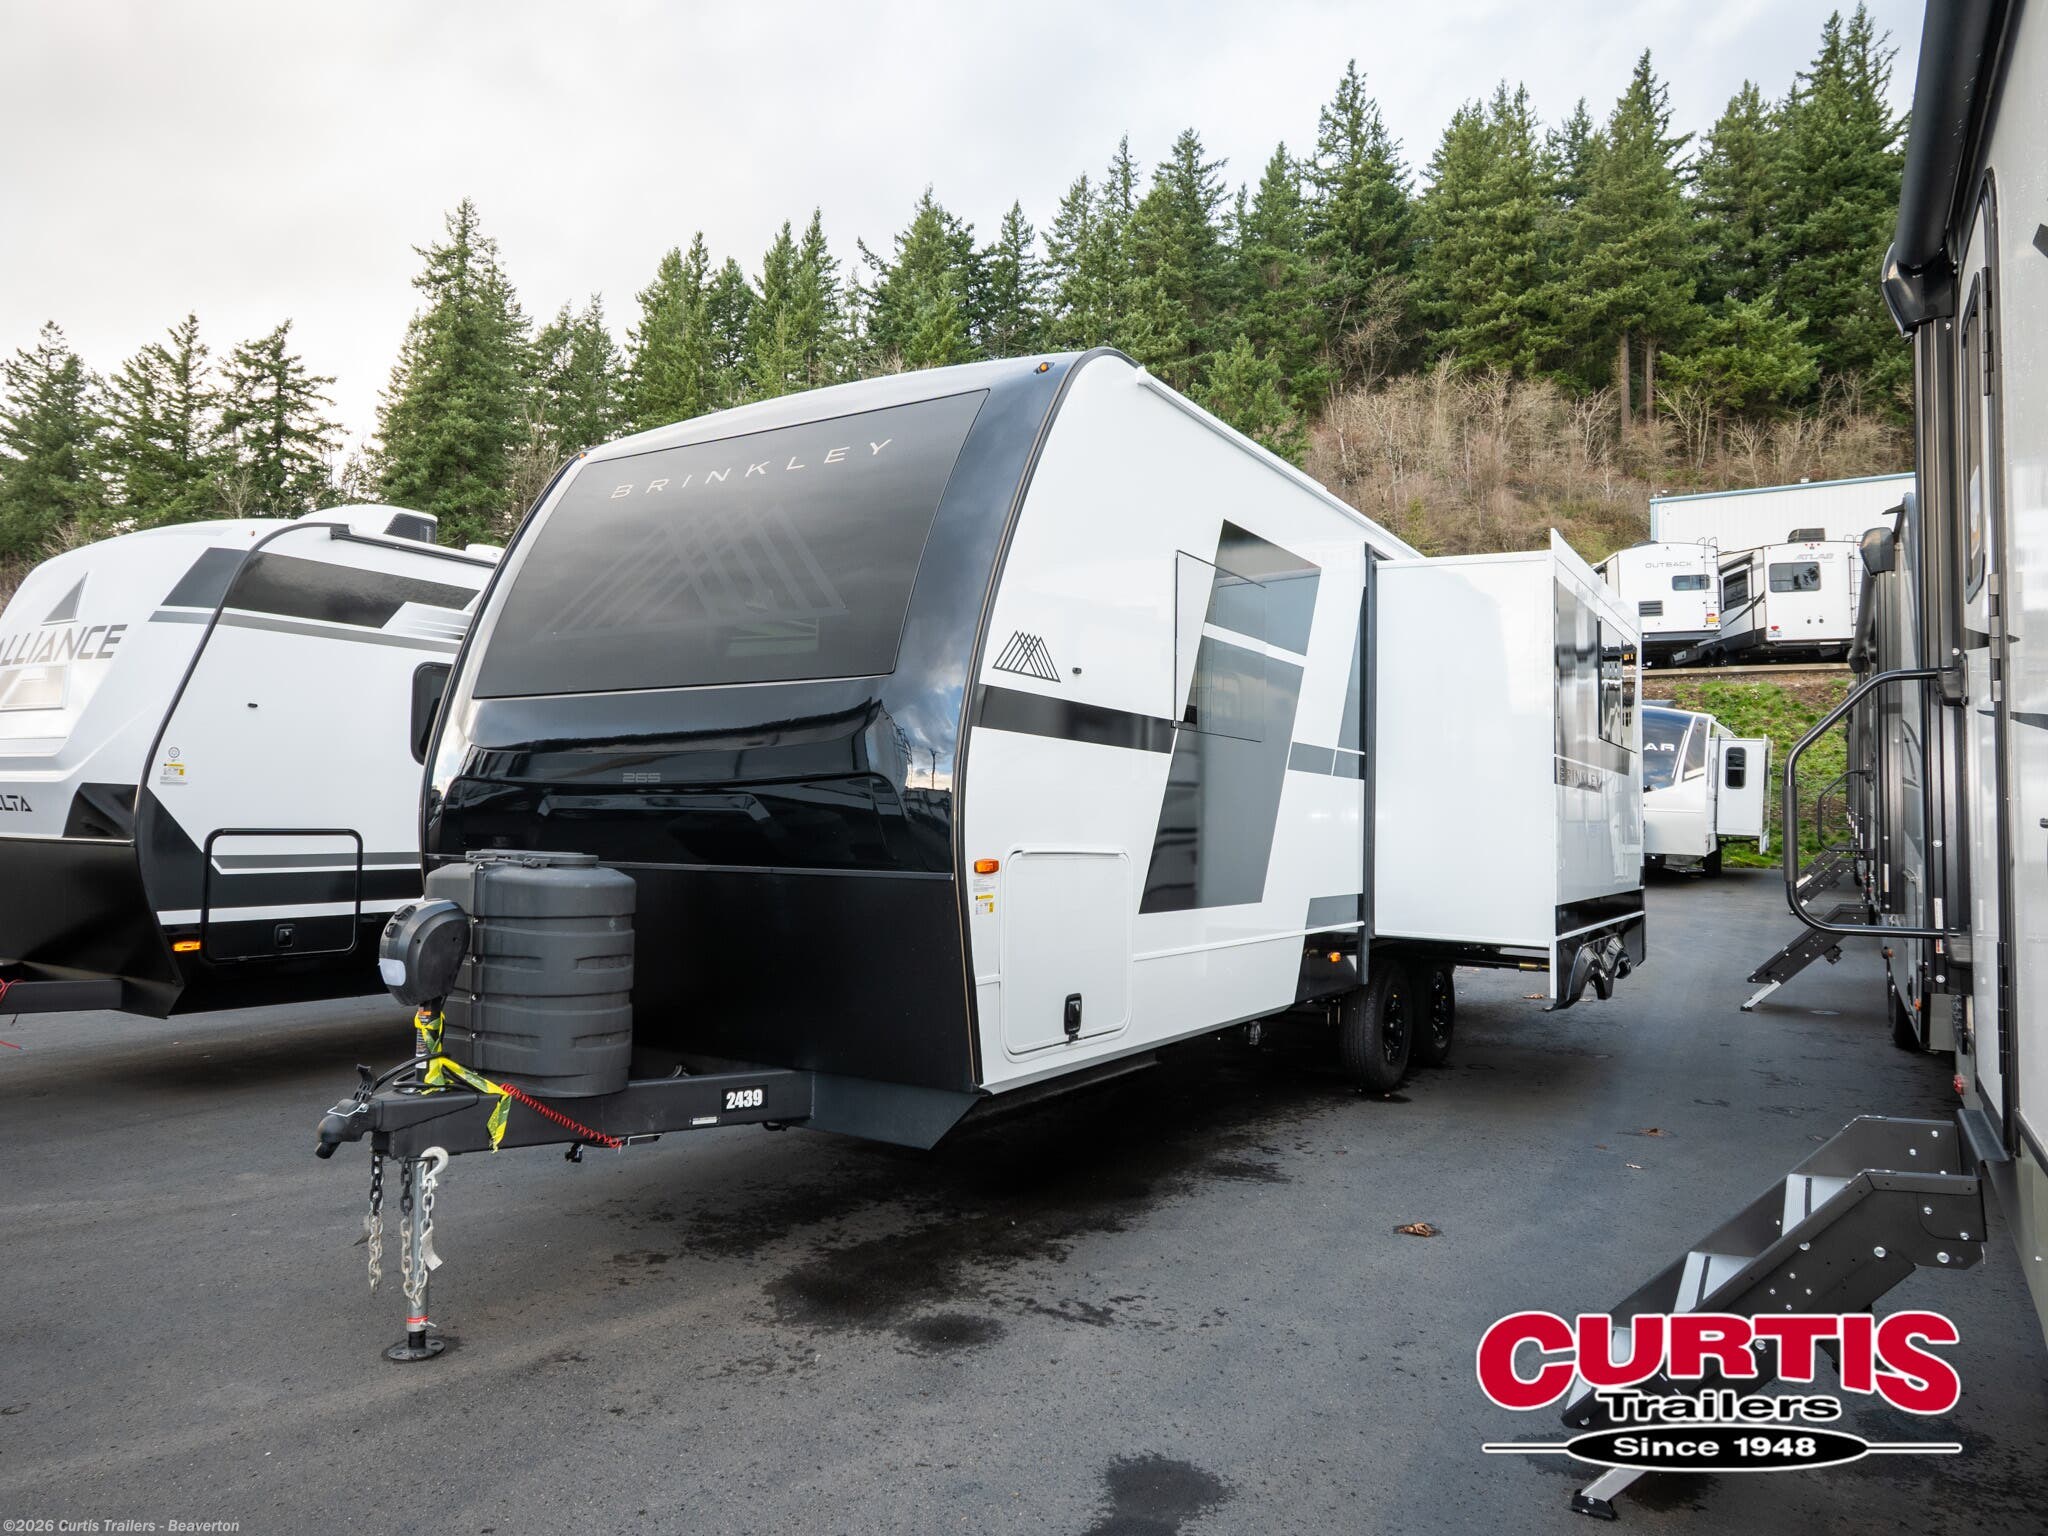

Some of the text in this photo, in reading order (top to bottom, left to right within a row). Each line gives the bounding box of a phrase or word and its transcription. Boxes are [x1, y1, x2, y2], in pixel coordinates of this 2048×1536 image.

[609, 438, 893, 499] BRINKLEY
[1645, 560, 1692, 569] OUTBACK
[1643, 742, 1675, 752] AR
[622, 772, 661, 783] 265
[0, 794, 32, 812] LTA
[725, 1088, 763, 1110] 2439
